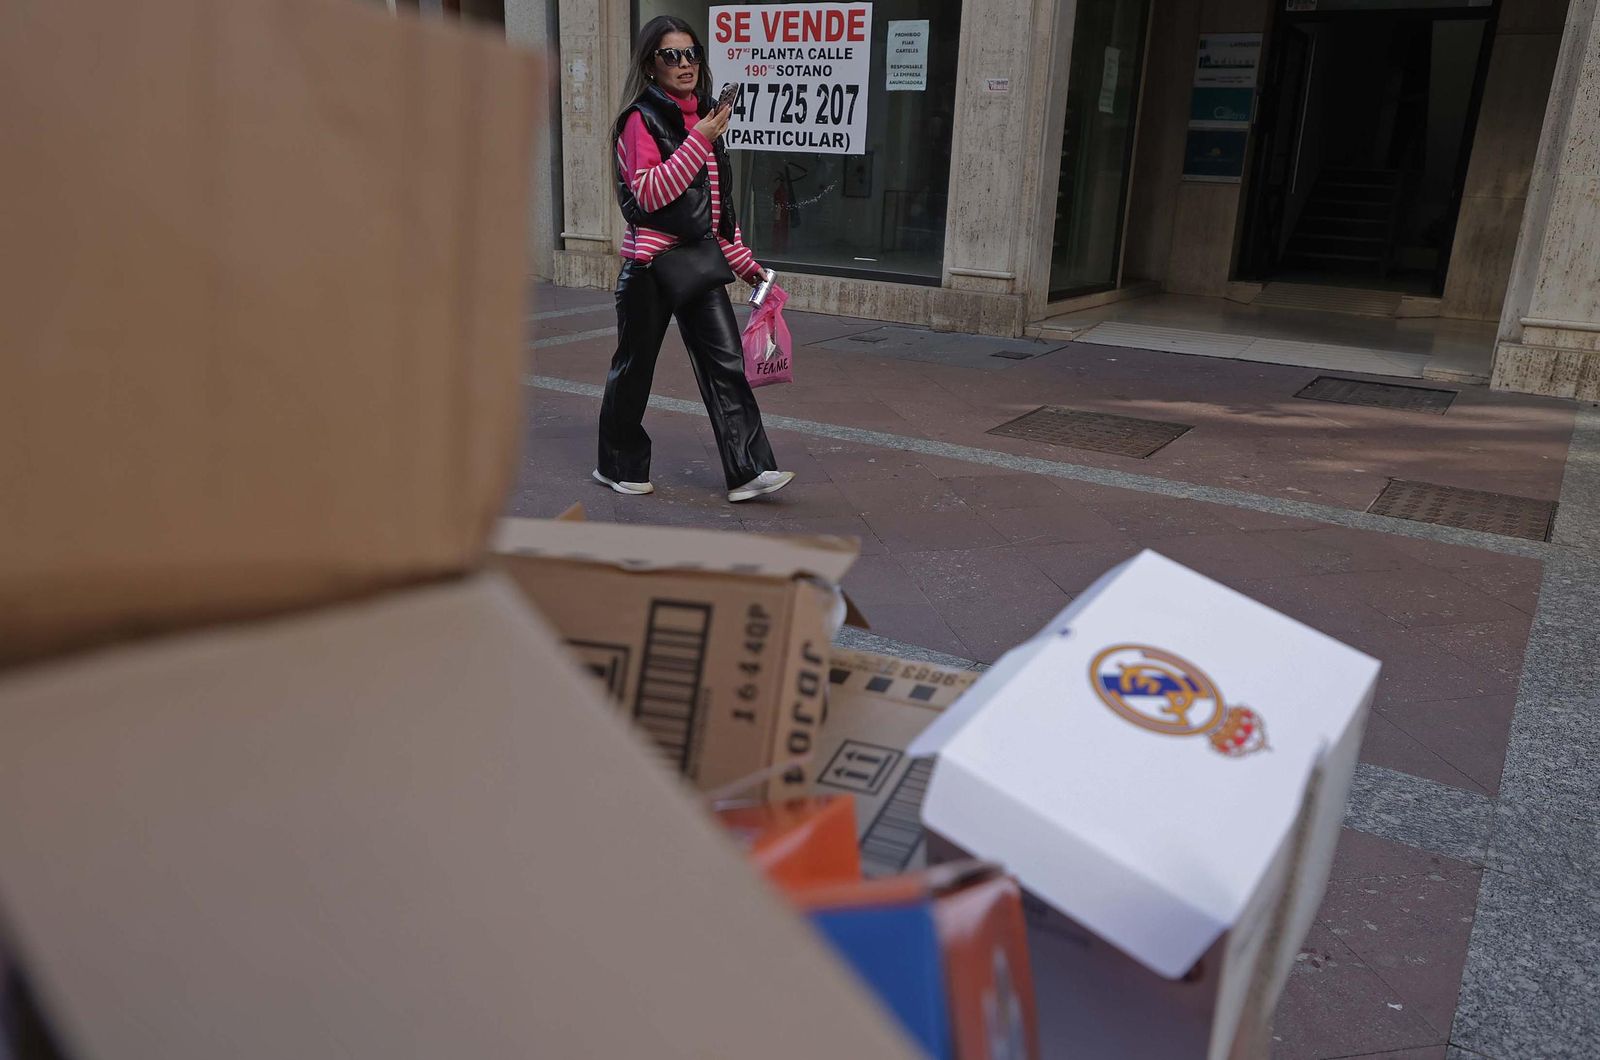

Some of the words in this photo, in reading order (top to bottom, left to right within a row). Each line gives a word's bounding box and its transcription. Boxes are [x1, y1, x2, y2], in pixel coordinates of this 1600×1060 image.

[715, 11, 751, 43] SE
[761, 9, 866, 43] VENDE
[751, 48, 804, 60] PLANTA
[808, 48, 853, 60] CALLE
[776, 64, 832, 77] SOTANO
[722, 82, 760, 122] 47
[767, 83, 808, 124] 725
[815, 84, 859, 125] 207
[725, 129, 851, 152] (PARTICULAR)
